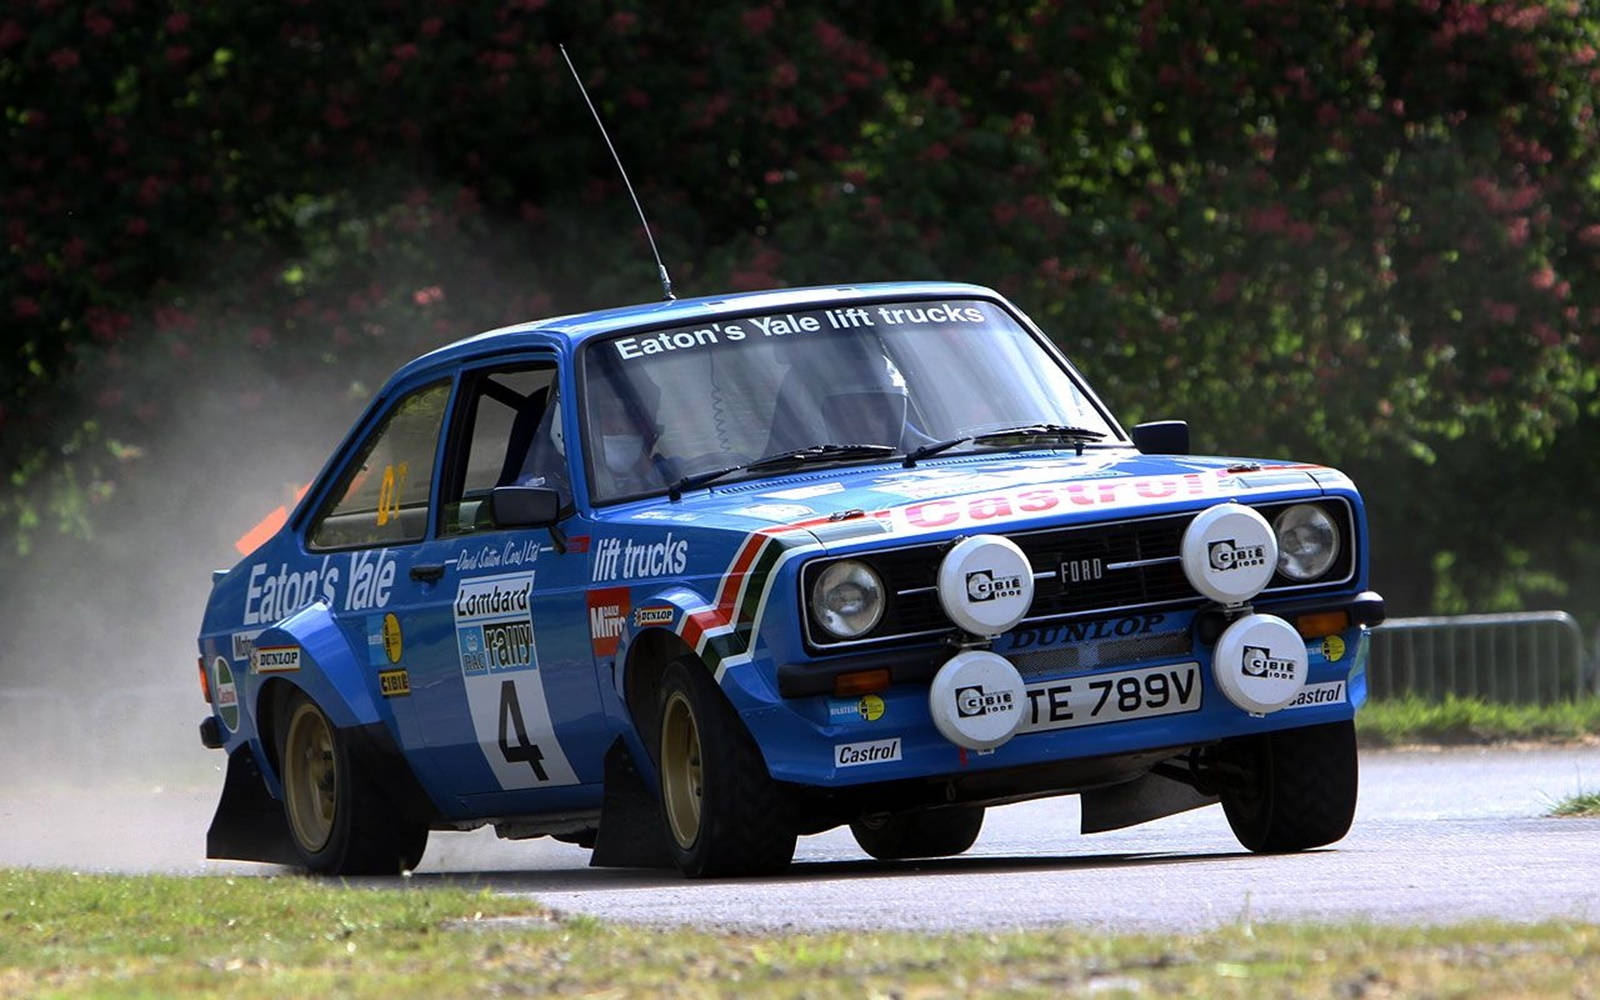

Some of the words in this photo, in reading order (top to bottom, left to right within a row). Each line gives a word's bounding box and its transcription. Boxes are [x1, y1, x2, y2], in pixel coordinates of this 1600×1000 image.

[614, 323, 746, 360] Eaton's
[748, 314, 820, 337] Yale
[825, 308, 874, 329] lift
[878, 303, 985, 325] trucks
[905, 474, 1202, 528] Castrol
[592, 538, 620, 581] lift
[623, 532, 688, 579] trucks
[1061, 558, 1102, 583] FORD
[243, 555, 339, 625] Eaton's
[344, 548, 396, 611] Yale
[457, 582, 530, 616] Lombard
[641, 610, 672, 621] DUNLOP
[1008, 614, 1165, 649] DUNLOP
[260, 652, 298, 666] DUNLOP
[464, 651, 485, 670] RAC
[485, 623, 534, 669] rally
[1026, 685, 1073, 724] TE
[1089, 669, 1194, 716] 789V
[499, 680, 550, 781] 4
[840, 741, 896, 764] Castrol
